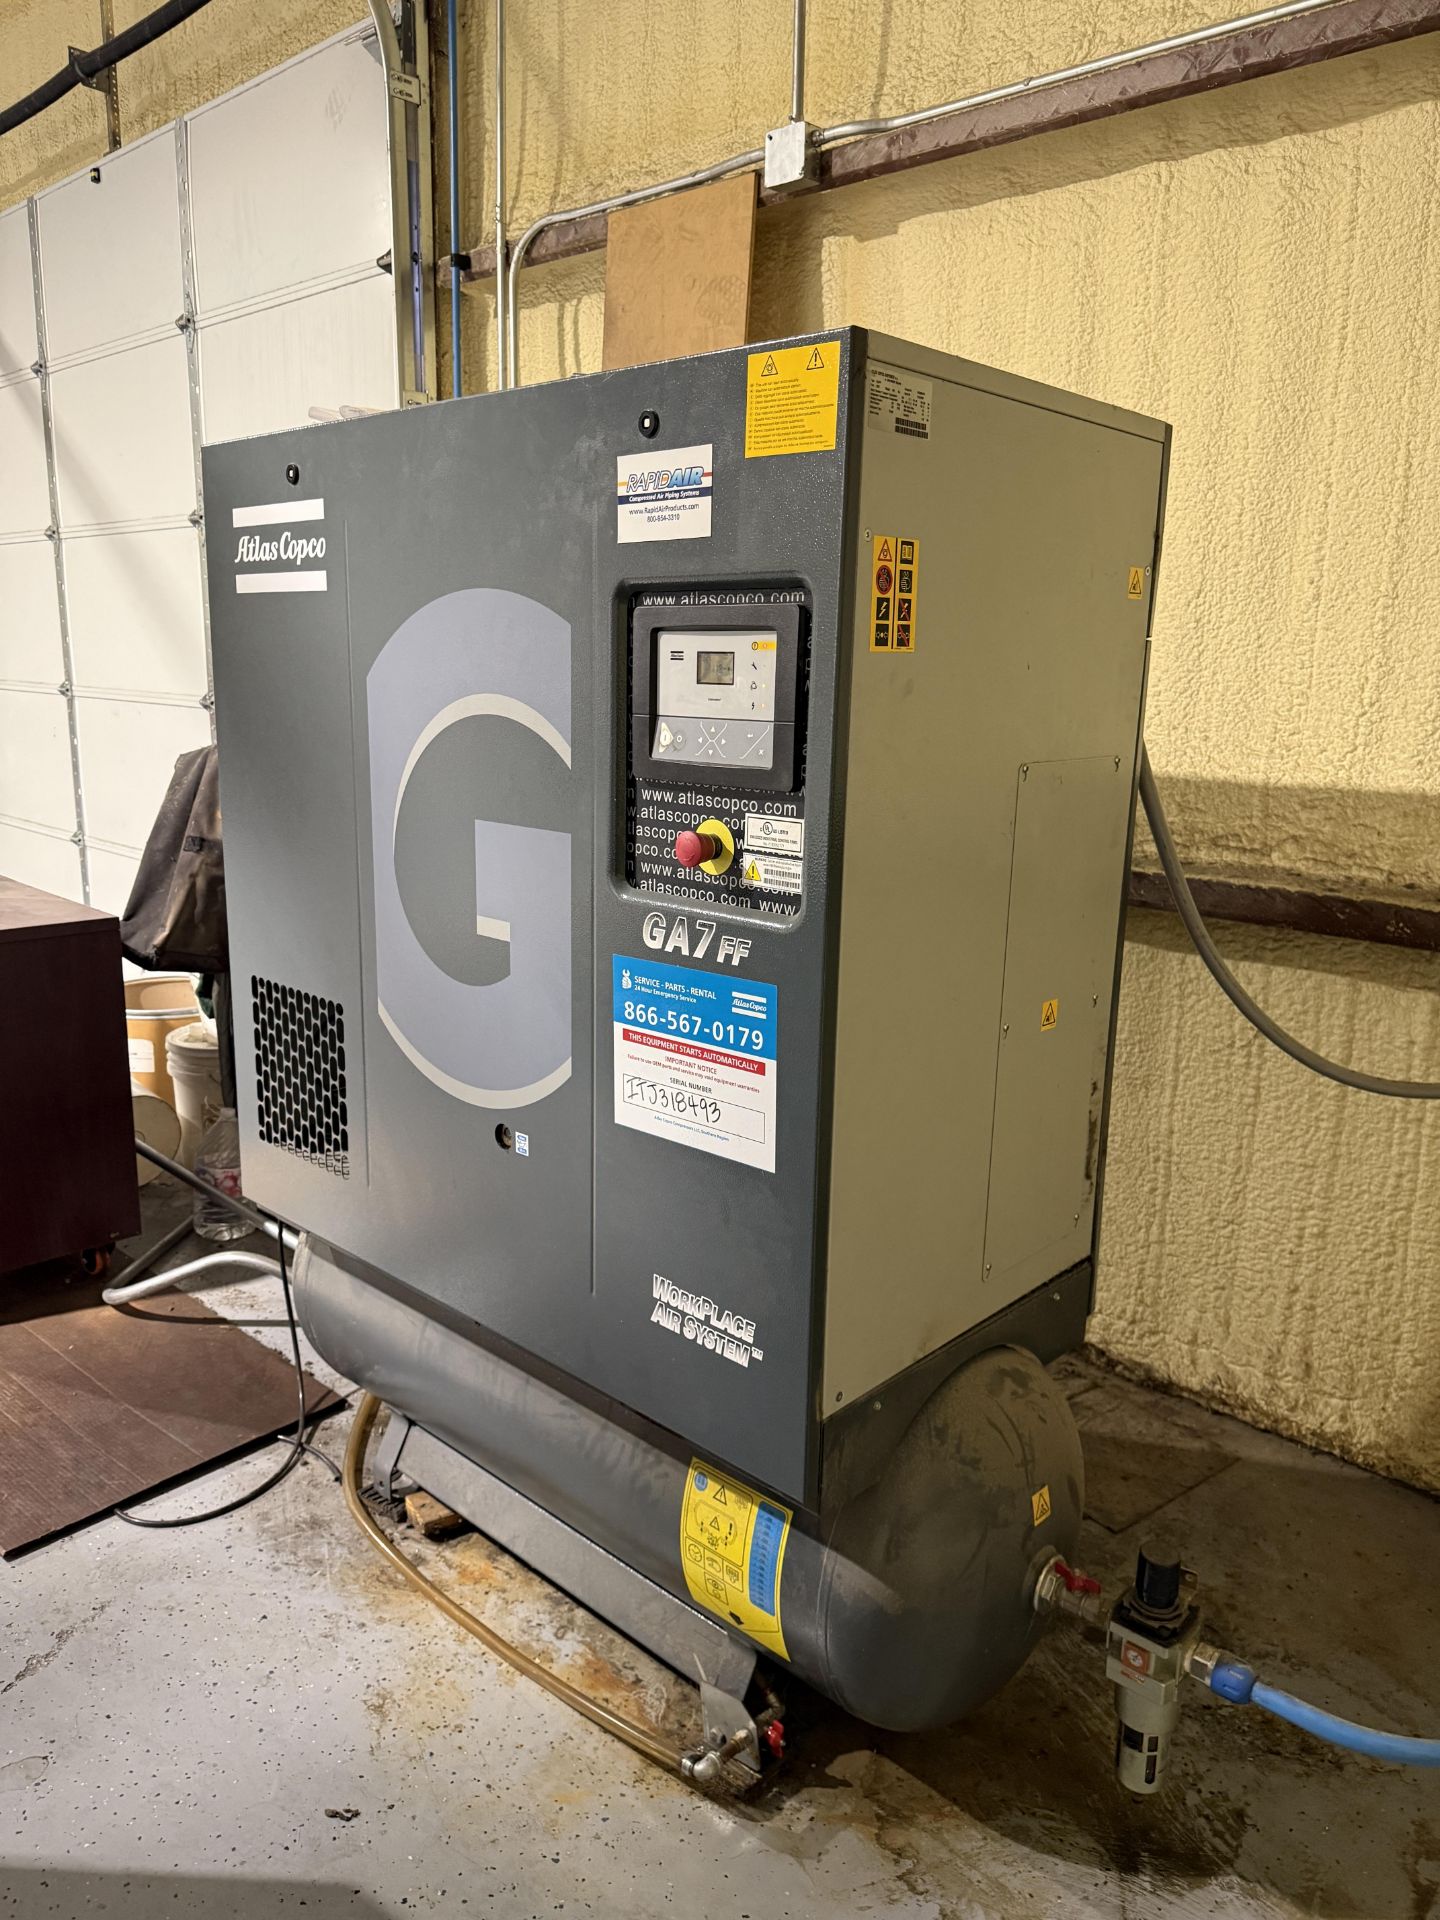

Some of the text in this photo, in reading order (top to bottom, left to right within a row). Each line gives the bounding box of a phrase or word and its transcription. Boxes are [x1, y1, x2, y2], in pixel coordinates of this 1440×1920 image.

[626, 466, 704, 493] RAPIDAIR
[628, 494, 656, 502] Compressed
[664, 492, 680, 500] Piping
[680, 490, 700, 498] Systems
[234, 532, 326, 566] Atlas Copco
[641, 788, 797, 816] www.atlascopco.com
[642, 912, 752, 966] GA7 FF
[634, 976, 660, 988] SERVICE
[665, 982, 686, 992] PARTS
[690, 987, 717, 1000] RENTAL
[640, 986, 653, 994] Hour
[654, 988, 678, 1000] Emergency
[680, 994, 697, 1003] Service
[732, 998, 767, 1012] Atlas Copco
[624, 1001, 764, 1050] 866-567-0179
[628, 1032, 758, 1071] THIS EQUIPMENT STARTS AUTOMATICALLY
[664, 1056, 717, 1074] IMPORTANT NOTICE
[670, 1077, 712, 1094] SERIAL NUMBER
[650, 1300, 682, 1334] AIR
